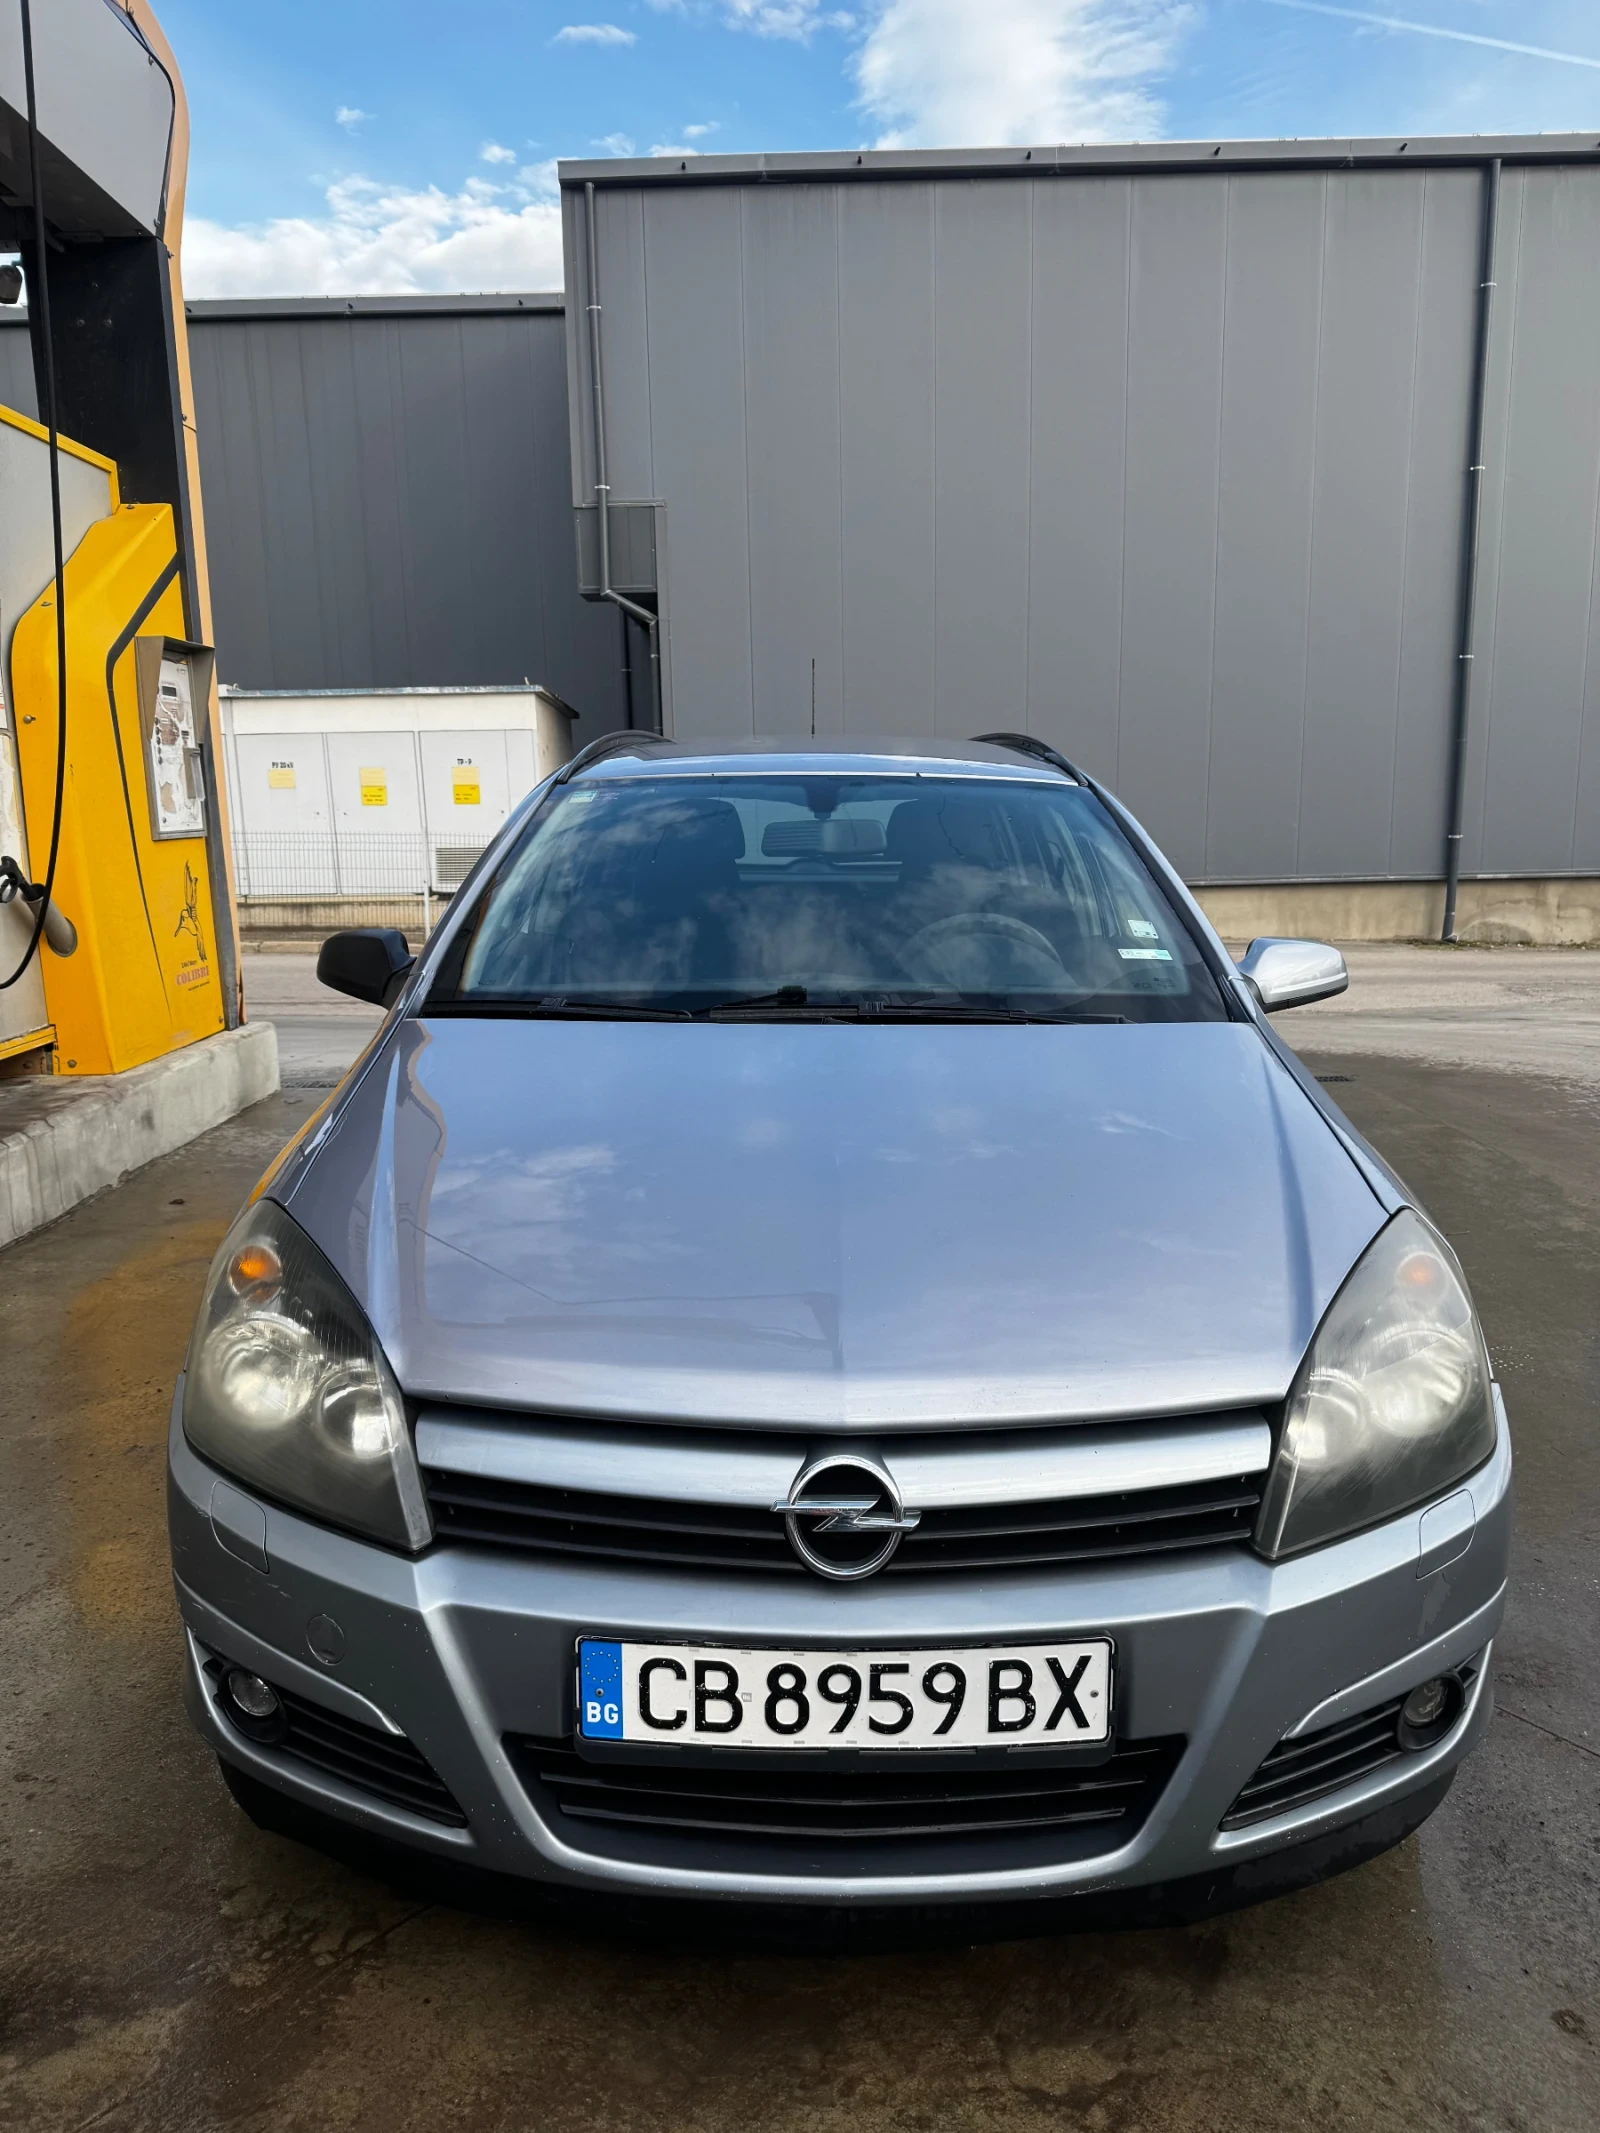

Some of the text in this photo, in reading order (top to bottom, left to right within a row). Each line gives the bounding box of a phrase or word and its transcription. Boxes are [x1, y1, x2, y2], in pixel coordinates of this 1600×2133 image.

[176, 965, 209, 986] COLIBRI
[638, 1655, 1092, 1735] CB 8959 BX
[586, 1701, 619, 1724] BG
